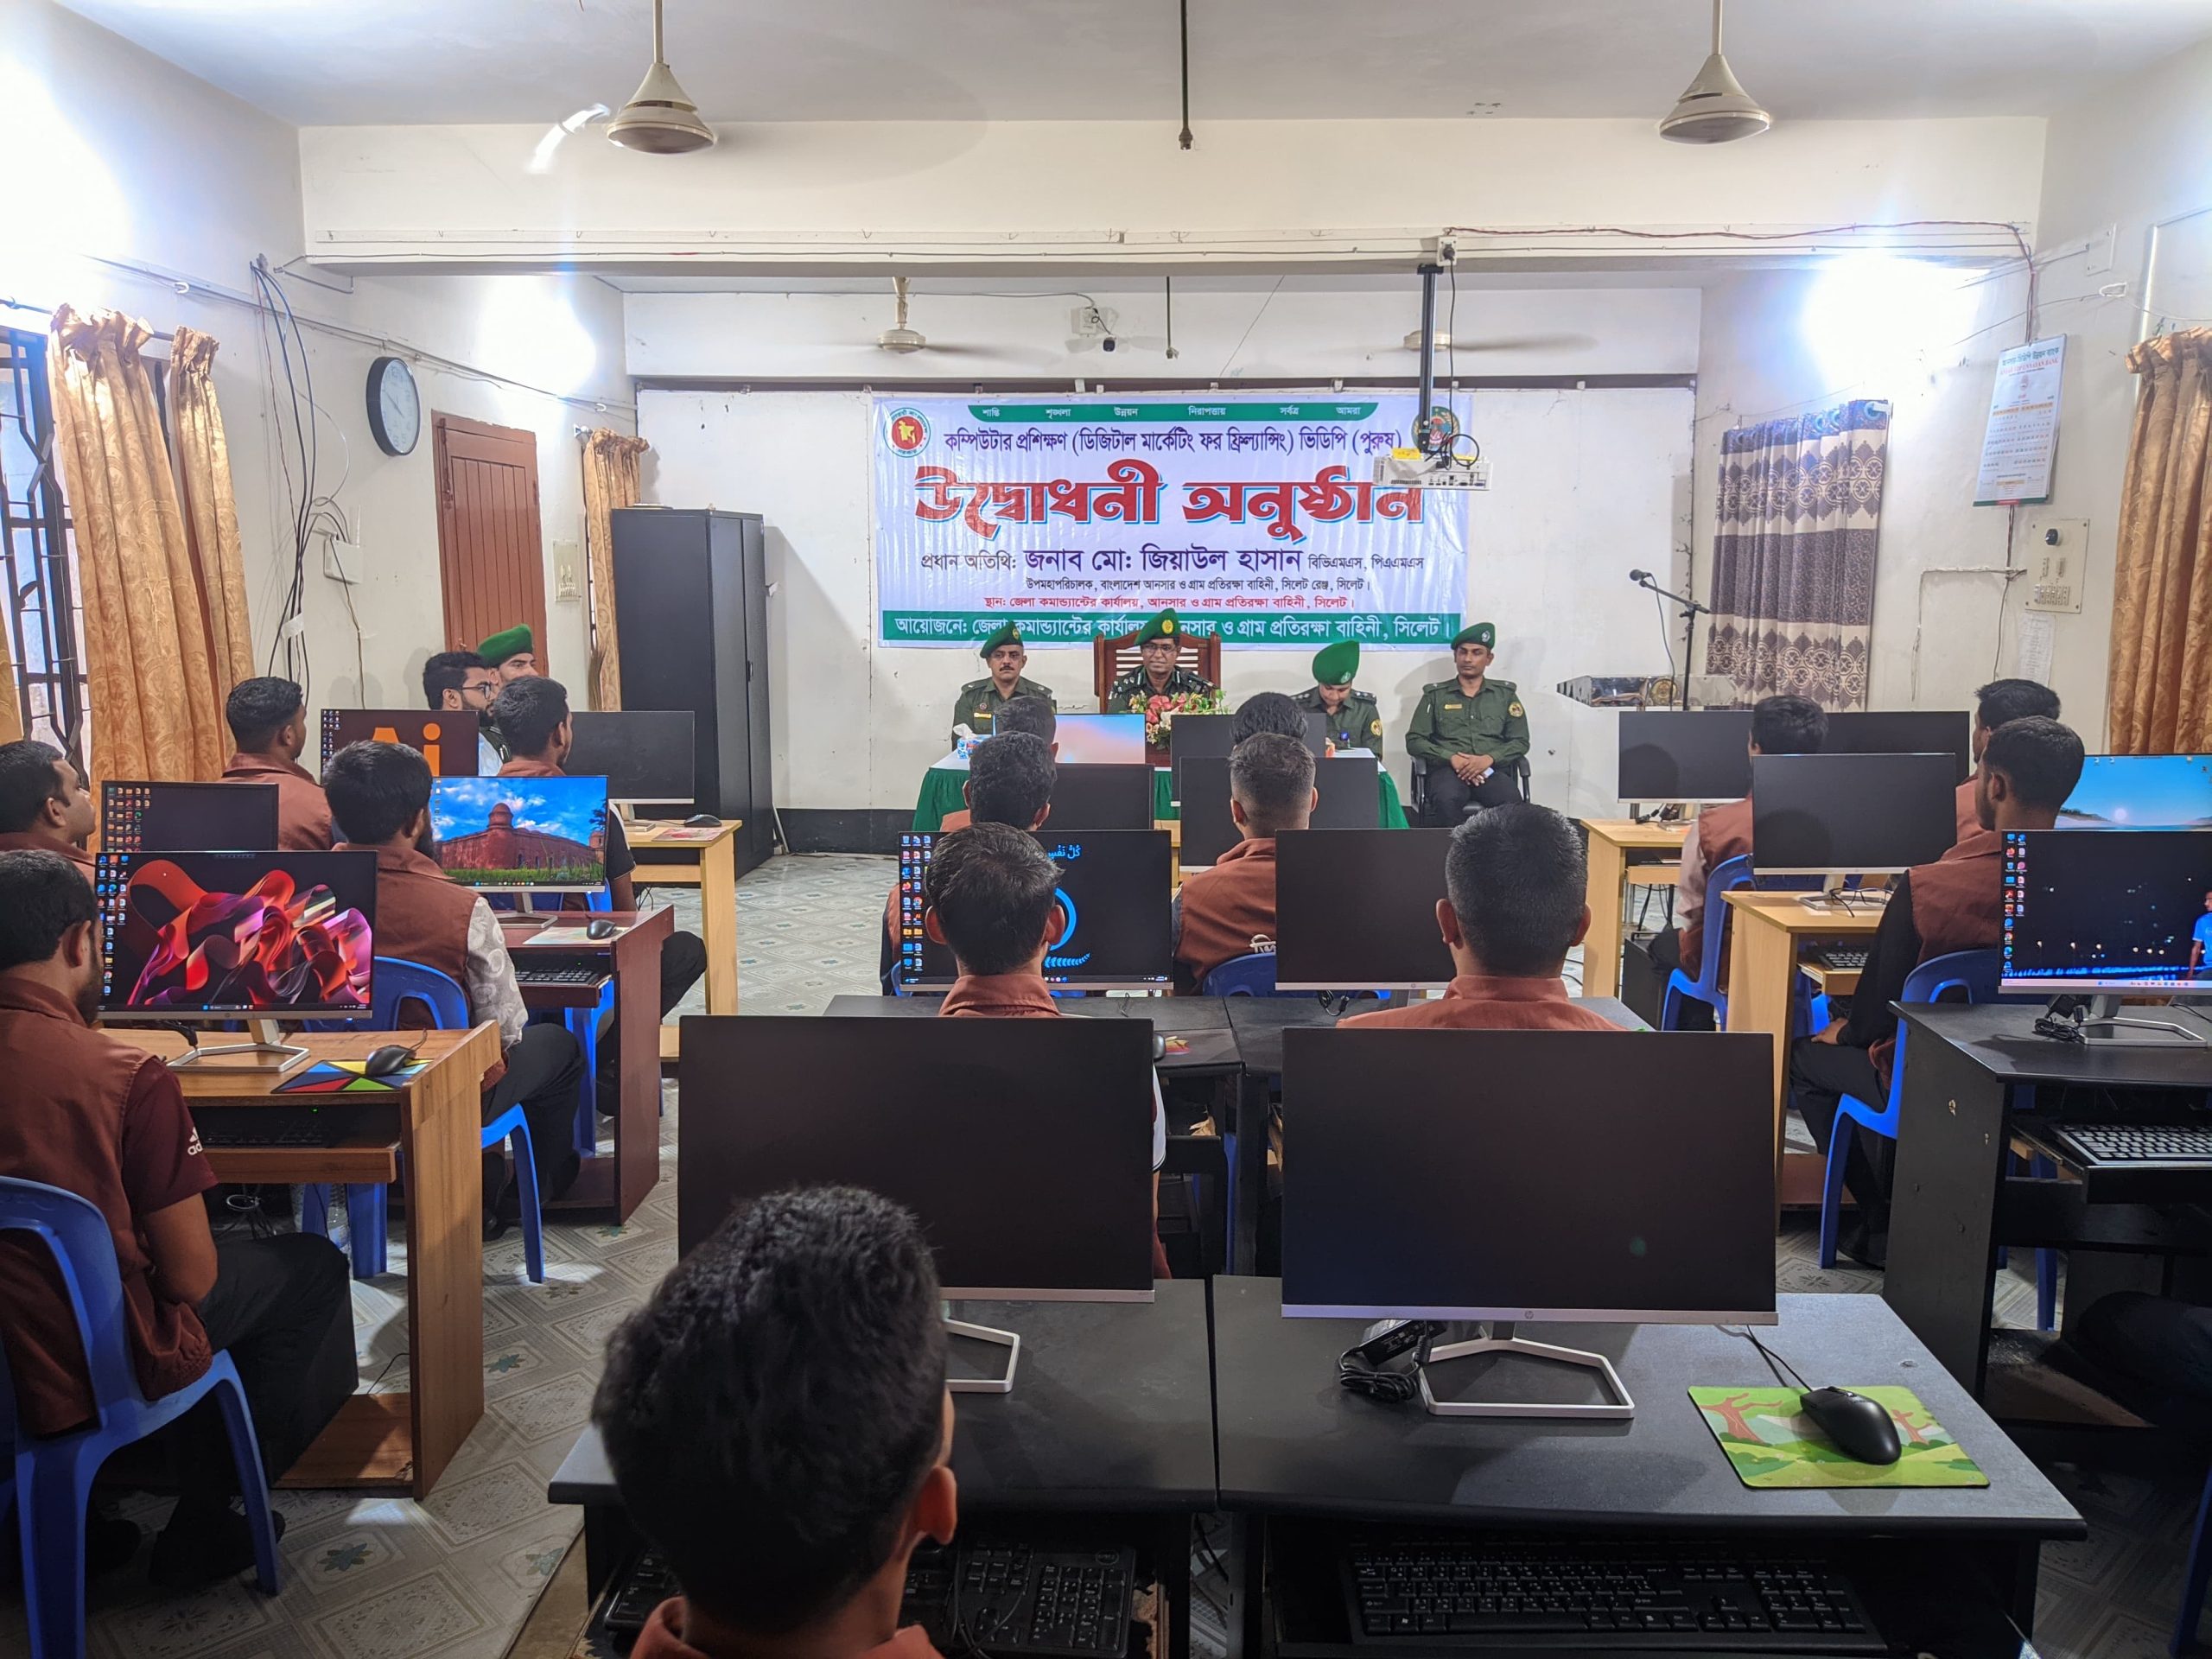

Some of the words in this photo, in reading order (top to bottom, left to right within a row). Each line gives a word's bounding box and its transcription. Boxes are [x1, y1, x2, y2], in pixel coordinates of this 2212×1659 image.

[944, 427, 1014, 451] কম্পিউটার
[1016, 427, 1067, 451] প্রশিক্ষণ
[1072, 427, 1137, 456] (ডিজিটাল
[1141, 426, 1195, 453] মার্কেটিং
[1198, 432, 1223, 450] ফর
[1299, 426, 1347, 450] ভিডিপি
[1352, 429, 1402, 455] (পুরুষ)
[914, 458, 1166, 541] উদ্বোধনী
[1181, 465, 1424, 543] অনুষ্ঠান
[921, 552, 959, 571] প্রধান
[1023, 549, 1084, 571] জনাব
[1139, 542, 1229, 571] জিয়াউল
[1236, 549, 1304, 572] হাসান
[1100, 579, 1141, 591] বাংলাদেশ
[1143, 579, 1175, 590] আনসার
[1179, 580, 1186, 590] ও
[1188, 579, 1205, 591] গ্রাম
[1208, 578, 1243, 591] প্রতিরক্ষা
[1281, 578, 1309, 591] সিলেট
[1009, 596, 1036, 607] জেলা
[1147, 597, 1185, 608] আনসার
[1190, 598, 1199, 607] ও
[1202, 597, 1221, 608] গ্রাম
[1225, 595, 1268, 608] প্রতিরক্ষা
[1178, 619, 1217, 636] নসার
[1222, 620, 1234, 637] ও
[1237, 619, 1266, 637] গ্রাম
[1270, 615, 1331, 637] প্রতিরক্ষা
